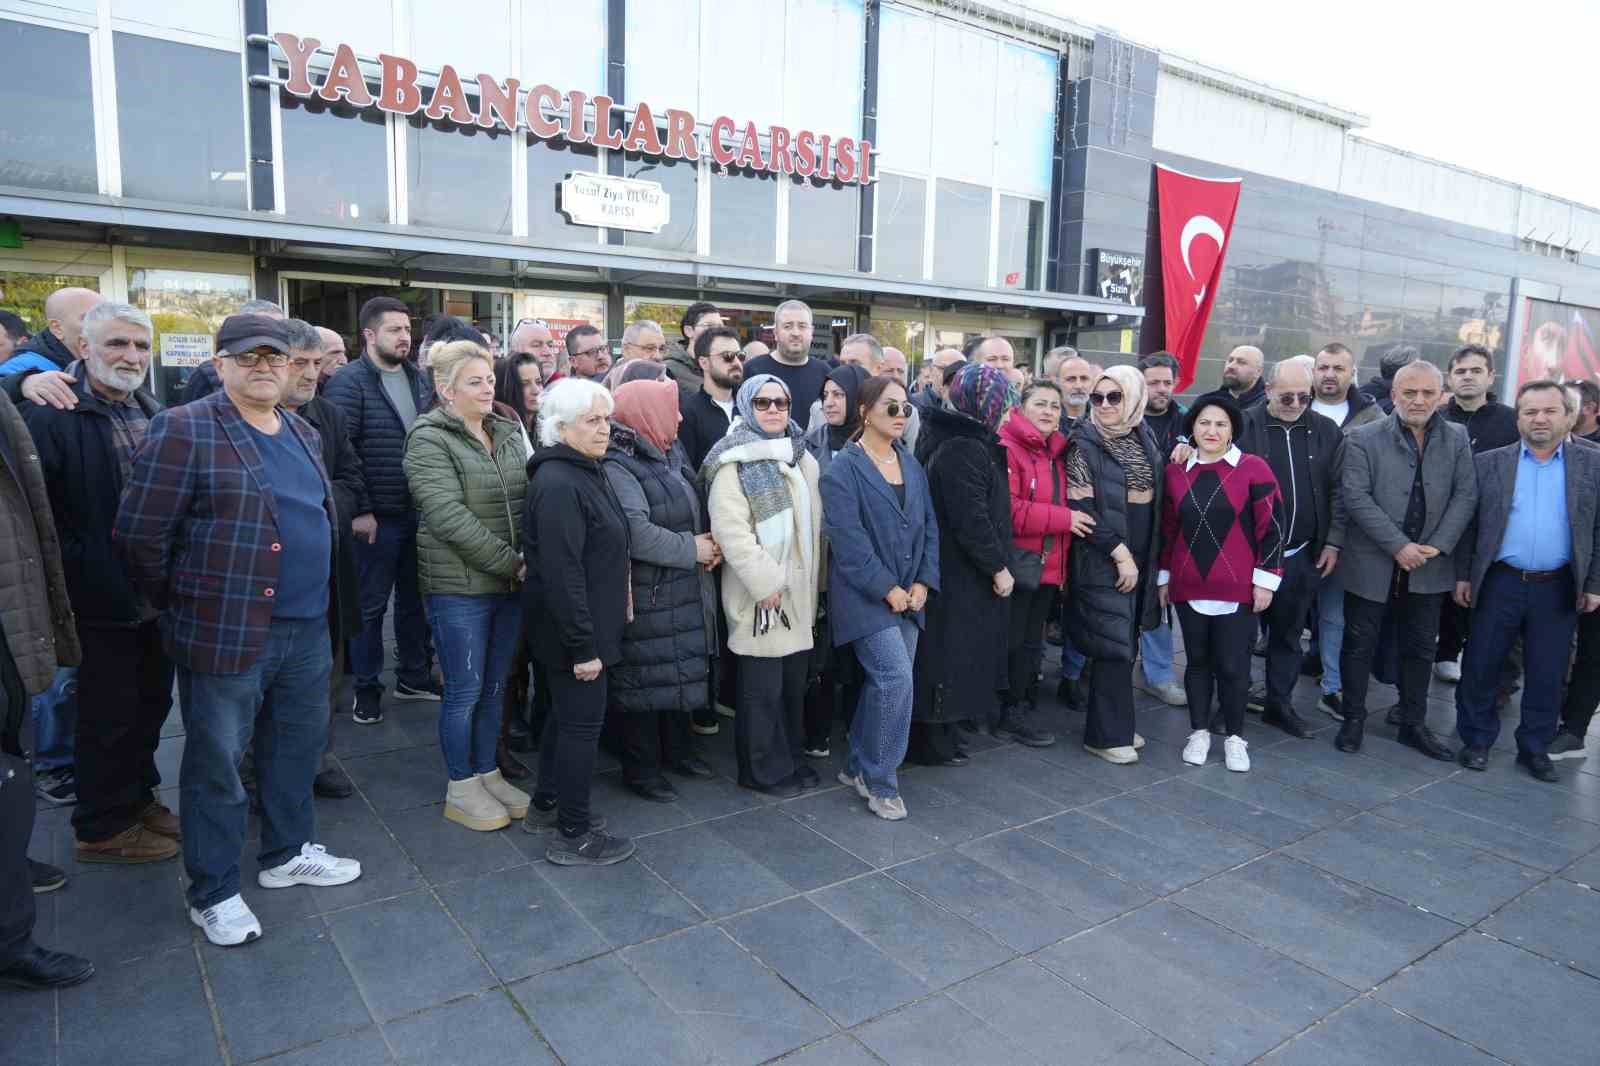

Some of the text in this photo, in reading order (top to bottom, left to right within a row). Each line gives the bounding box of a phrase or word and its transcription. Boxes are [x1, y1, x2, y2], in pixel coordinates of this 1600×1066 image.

[273, 32, 872, 190] YABANCILAR ÇARŞISI
[575, 183, 600, 197] Yusuf
[603, 187, 623, 202] Ziya
